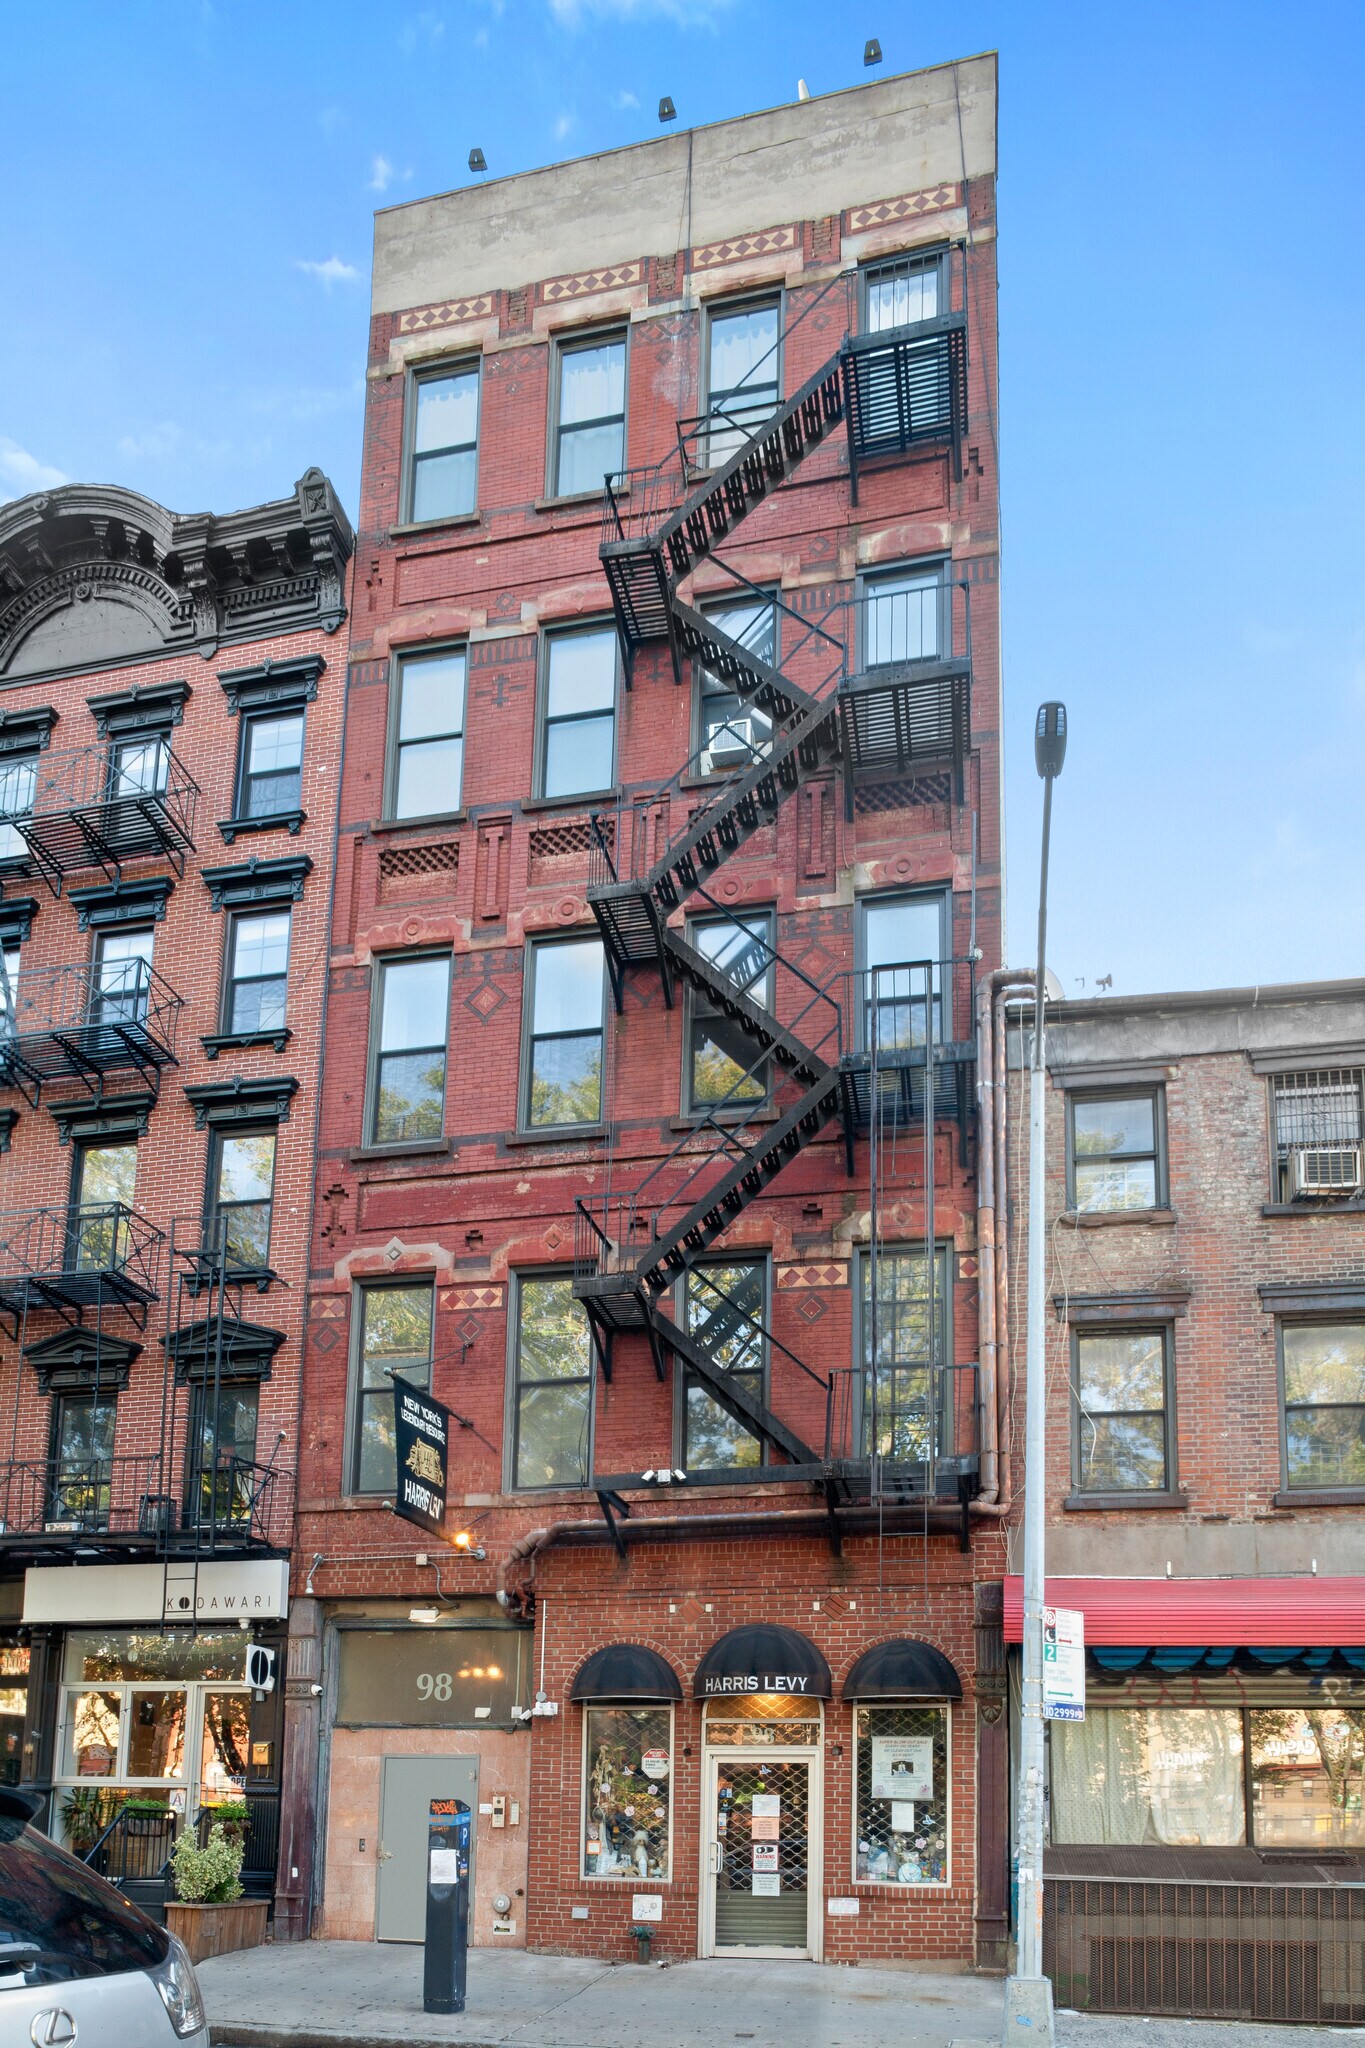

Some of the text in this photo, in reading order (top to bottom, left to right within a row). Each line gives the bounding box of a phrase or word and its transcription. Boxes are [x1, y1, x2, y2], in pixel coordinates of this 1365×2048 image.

[401, 1407, 426, 1432] LEGENDARY
[404, 1395, 442, 1427] NEW YORK'S
[404, 1479, 430, 1511] HARRIS
[166, 1596, 271, 1610] KODAWARI
[1046, 1646, 1055, 1661] 2
[416, 1673, 452, 1702] 98
[705, 1675, 808, 1692] HARRIS LEVY
[171, 1792, 182, 1807] A
